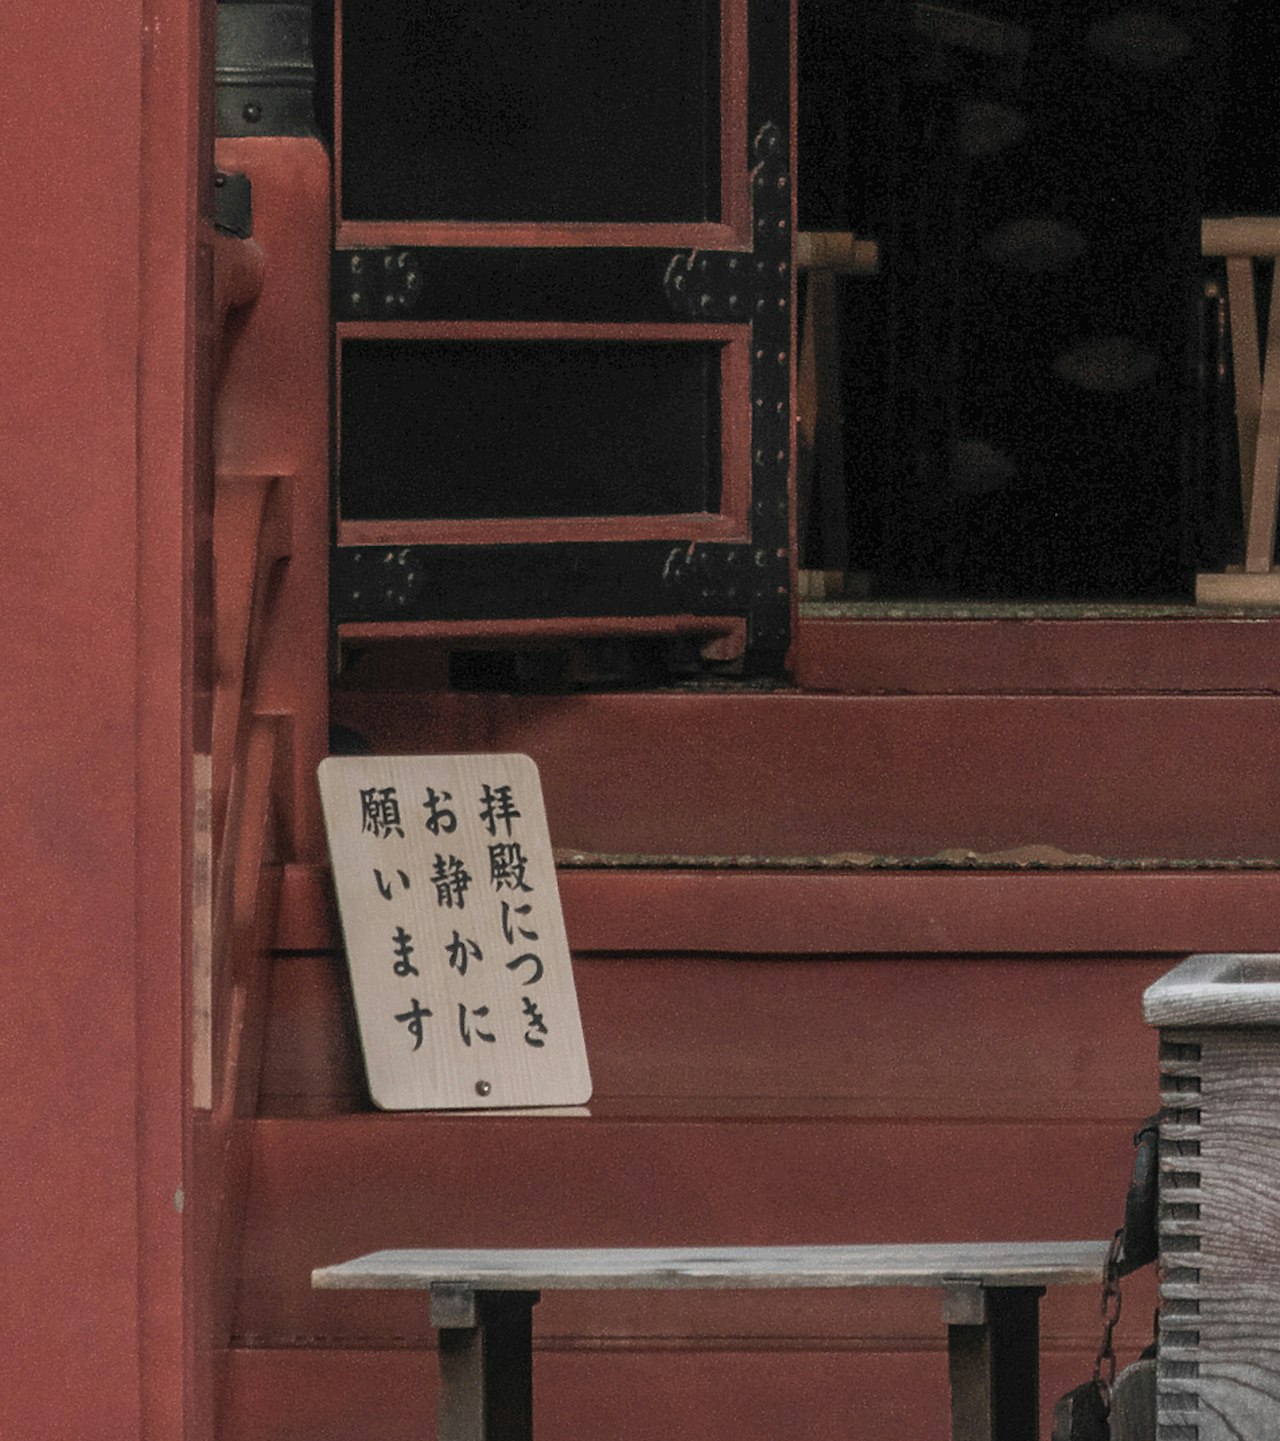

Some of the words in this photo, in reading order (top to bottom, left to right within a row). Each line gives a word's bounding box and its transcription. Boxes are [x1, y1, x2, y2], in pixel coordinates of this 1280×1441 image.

[359, 787, 433, 1051] 願います
[423, 787, 496, 1048] お静かに
[479, 784, 549, 1048] 拝殿につき
